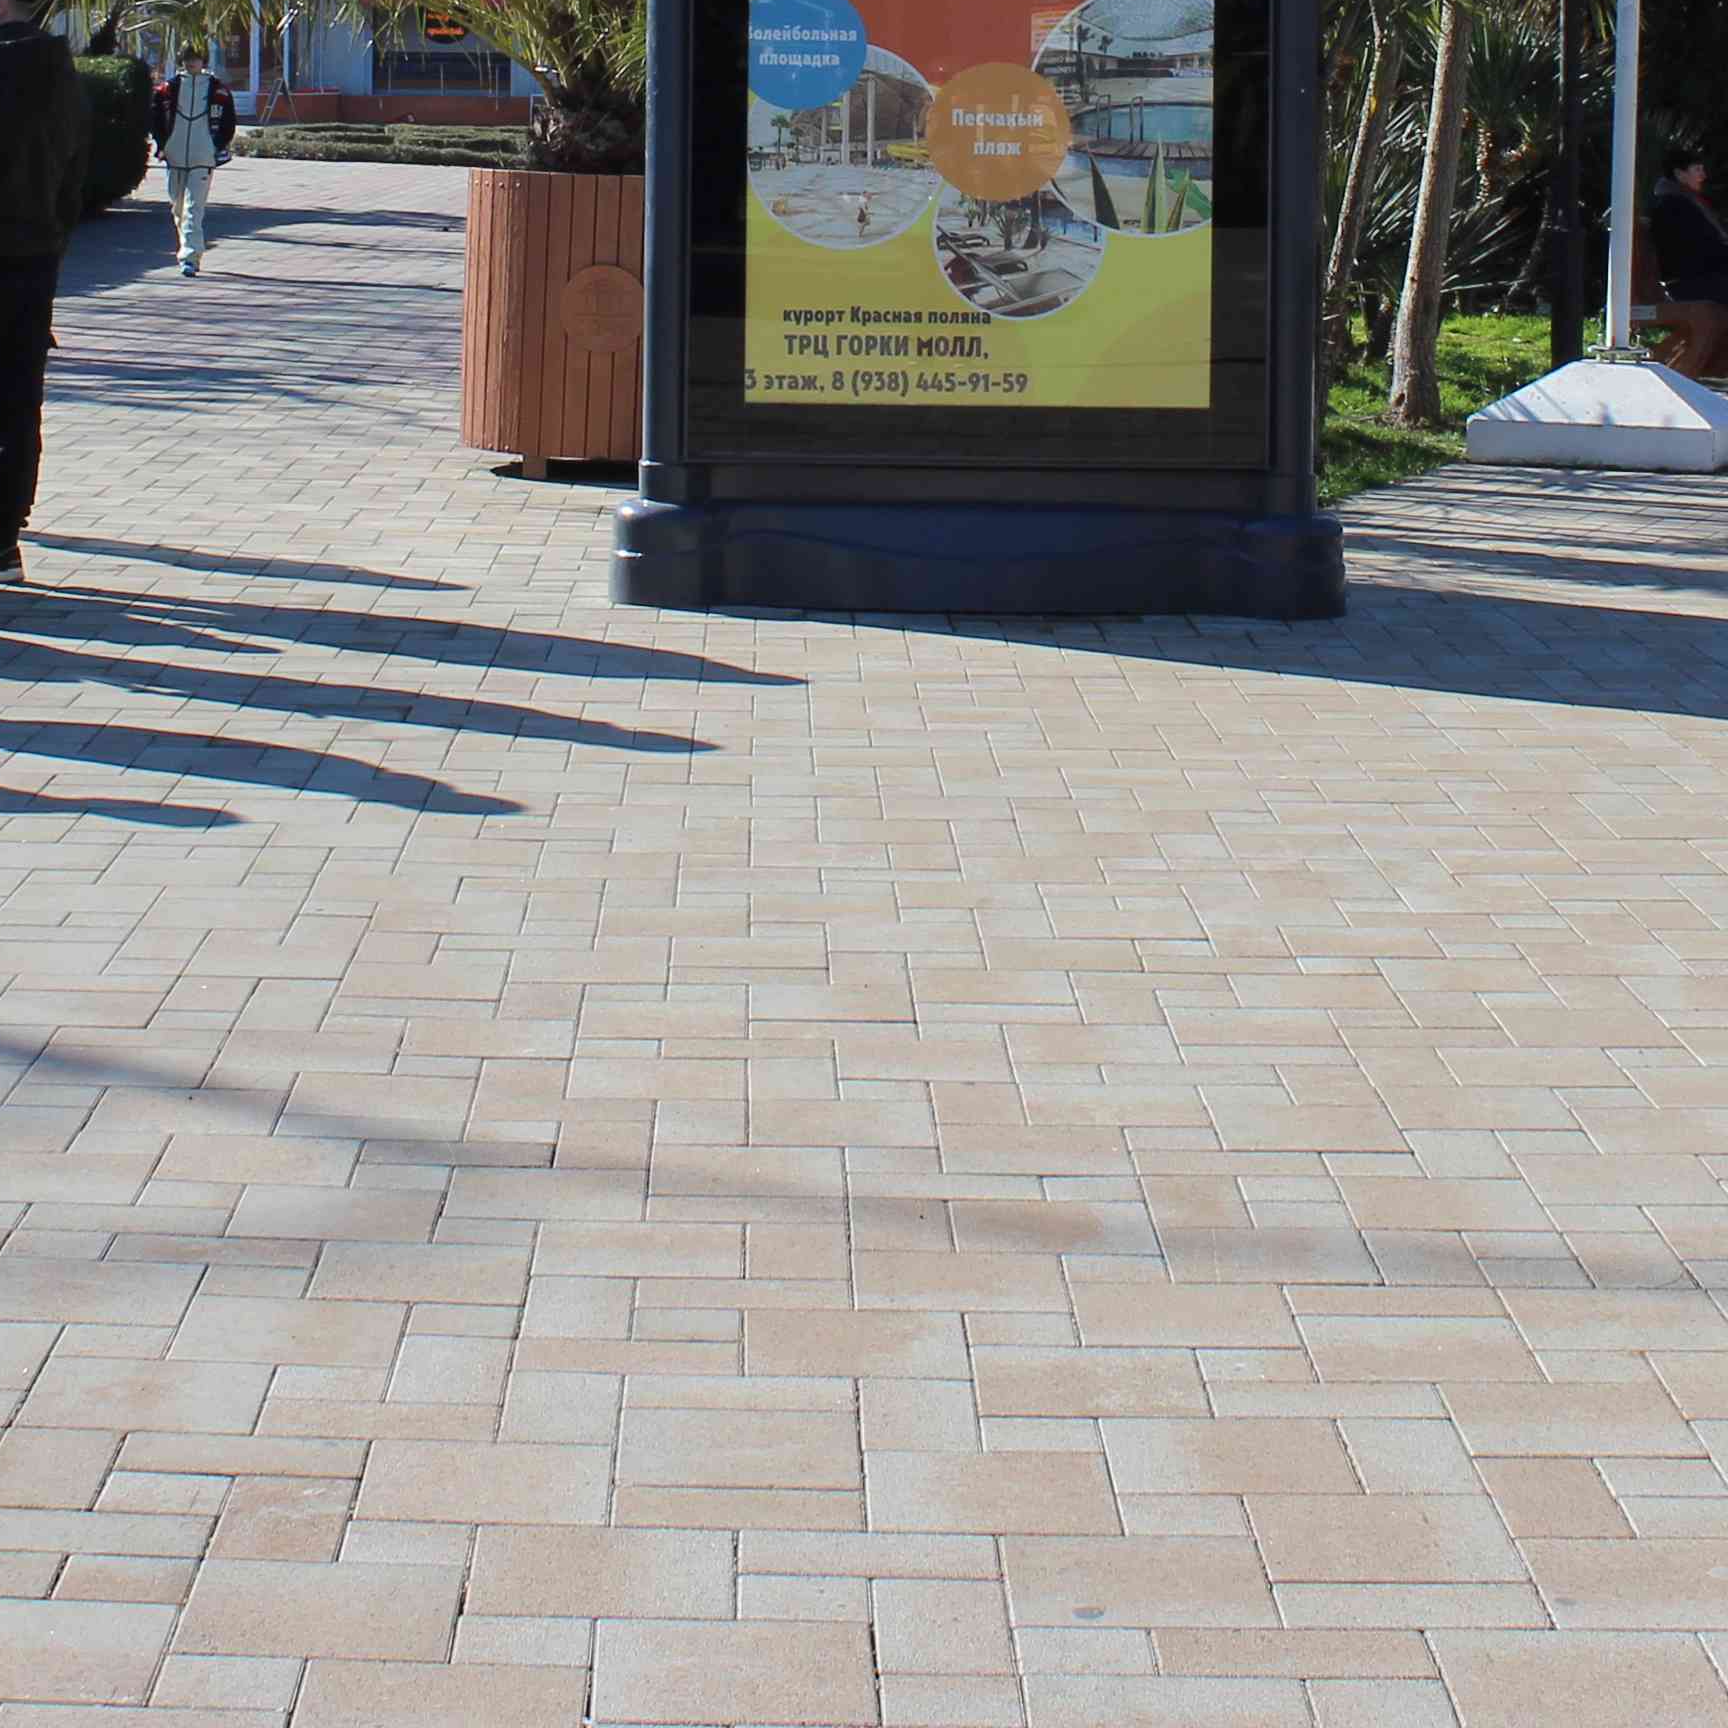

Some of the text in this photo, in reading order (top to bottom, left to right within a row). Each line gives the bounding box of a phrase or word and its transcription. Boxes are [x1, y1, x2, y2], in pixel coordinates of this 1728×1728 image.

[759, 52, 841, 68] площадка
[952, 108, 1044, 128] Песчаный
[974, 141, 1022, 156] пляж
[783, 306, 992, 326] курорт Красная поляна
[784, 334, 989, 359] ТРЦ ГОРКИ МОЛЛ,
[831, 371, 845, 391] 8
[851, 370, 909, 397] (938)
[915, 373, 1029, 393] 445-91-59
